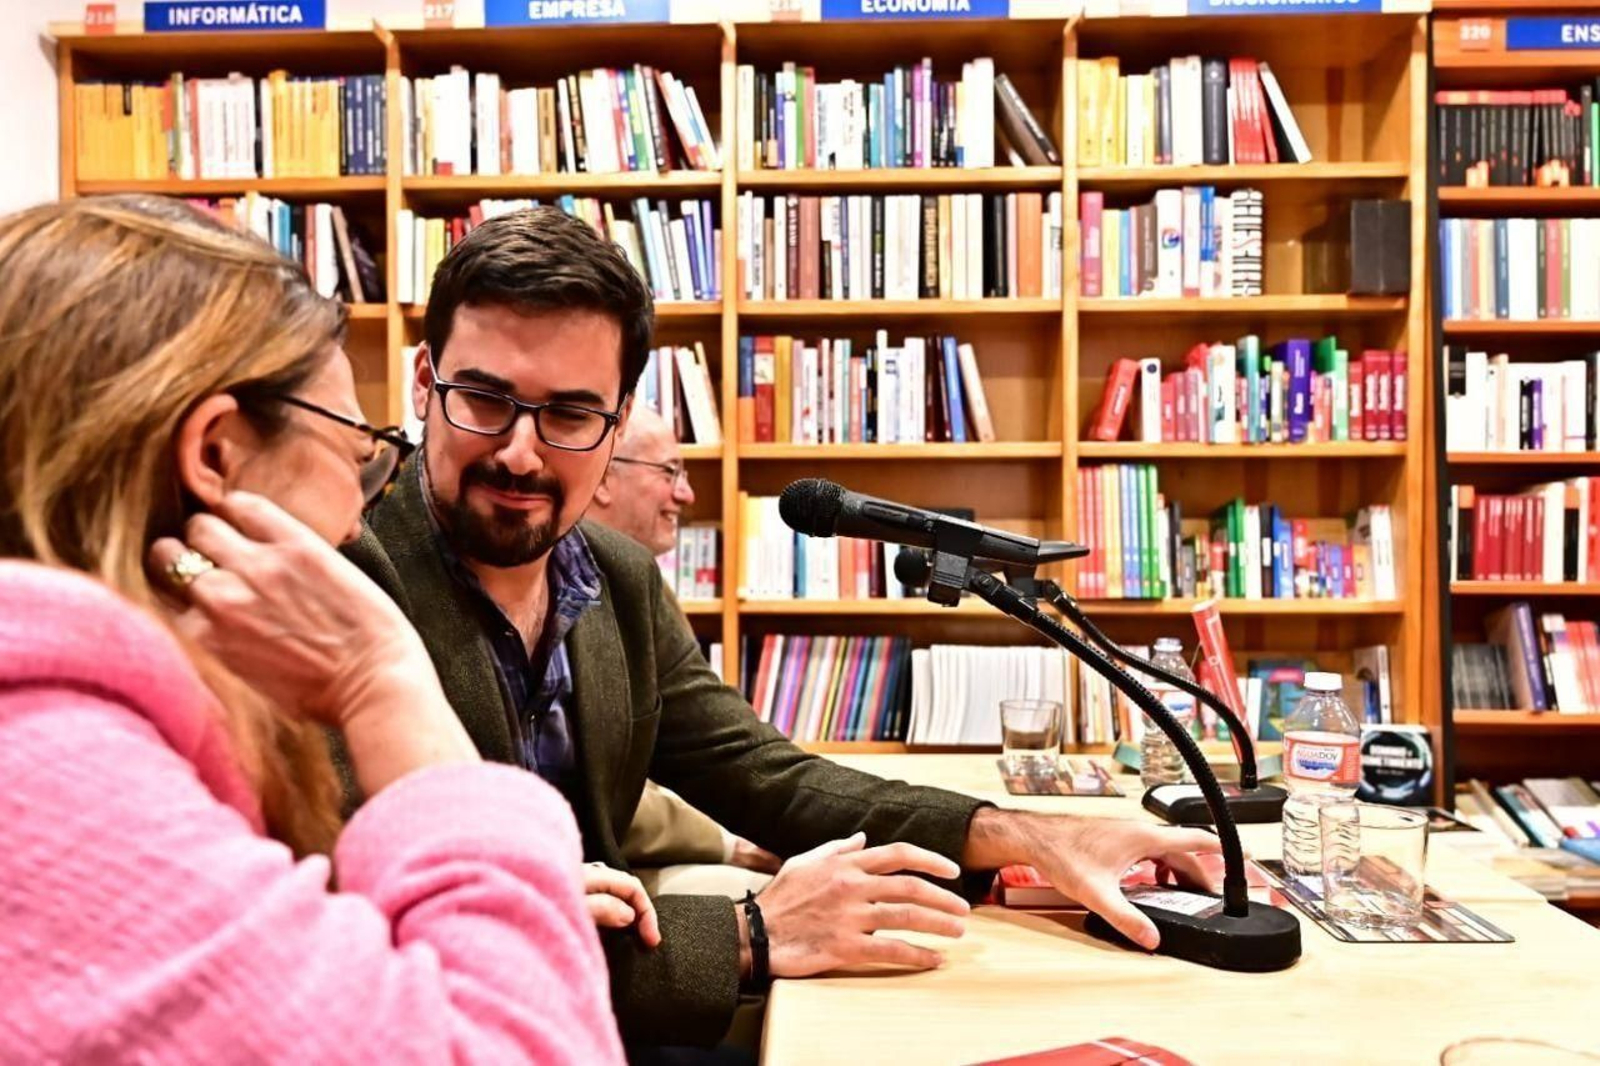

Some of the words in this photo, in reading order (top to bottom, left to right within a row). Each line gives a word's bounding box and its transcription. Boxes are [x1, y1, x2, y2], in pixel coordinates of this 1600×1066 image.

[168, 3, 303, 25] INFORMÁTICA
[529, 0, 626, 19] EMPRESA
[1561, 24, 1600, 43] ENS
